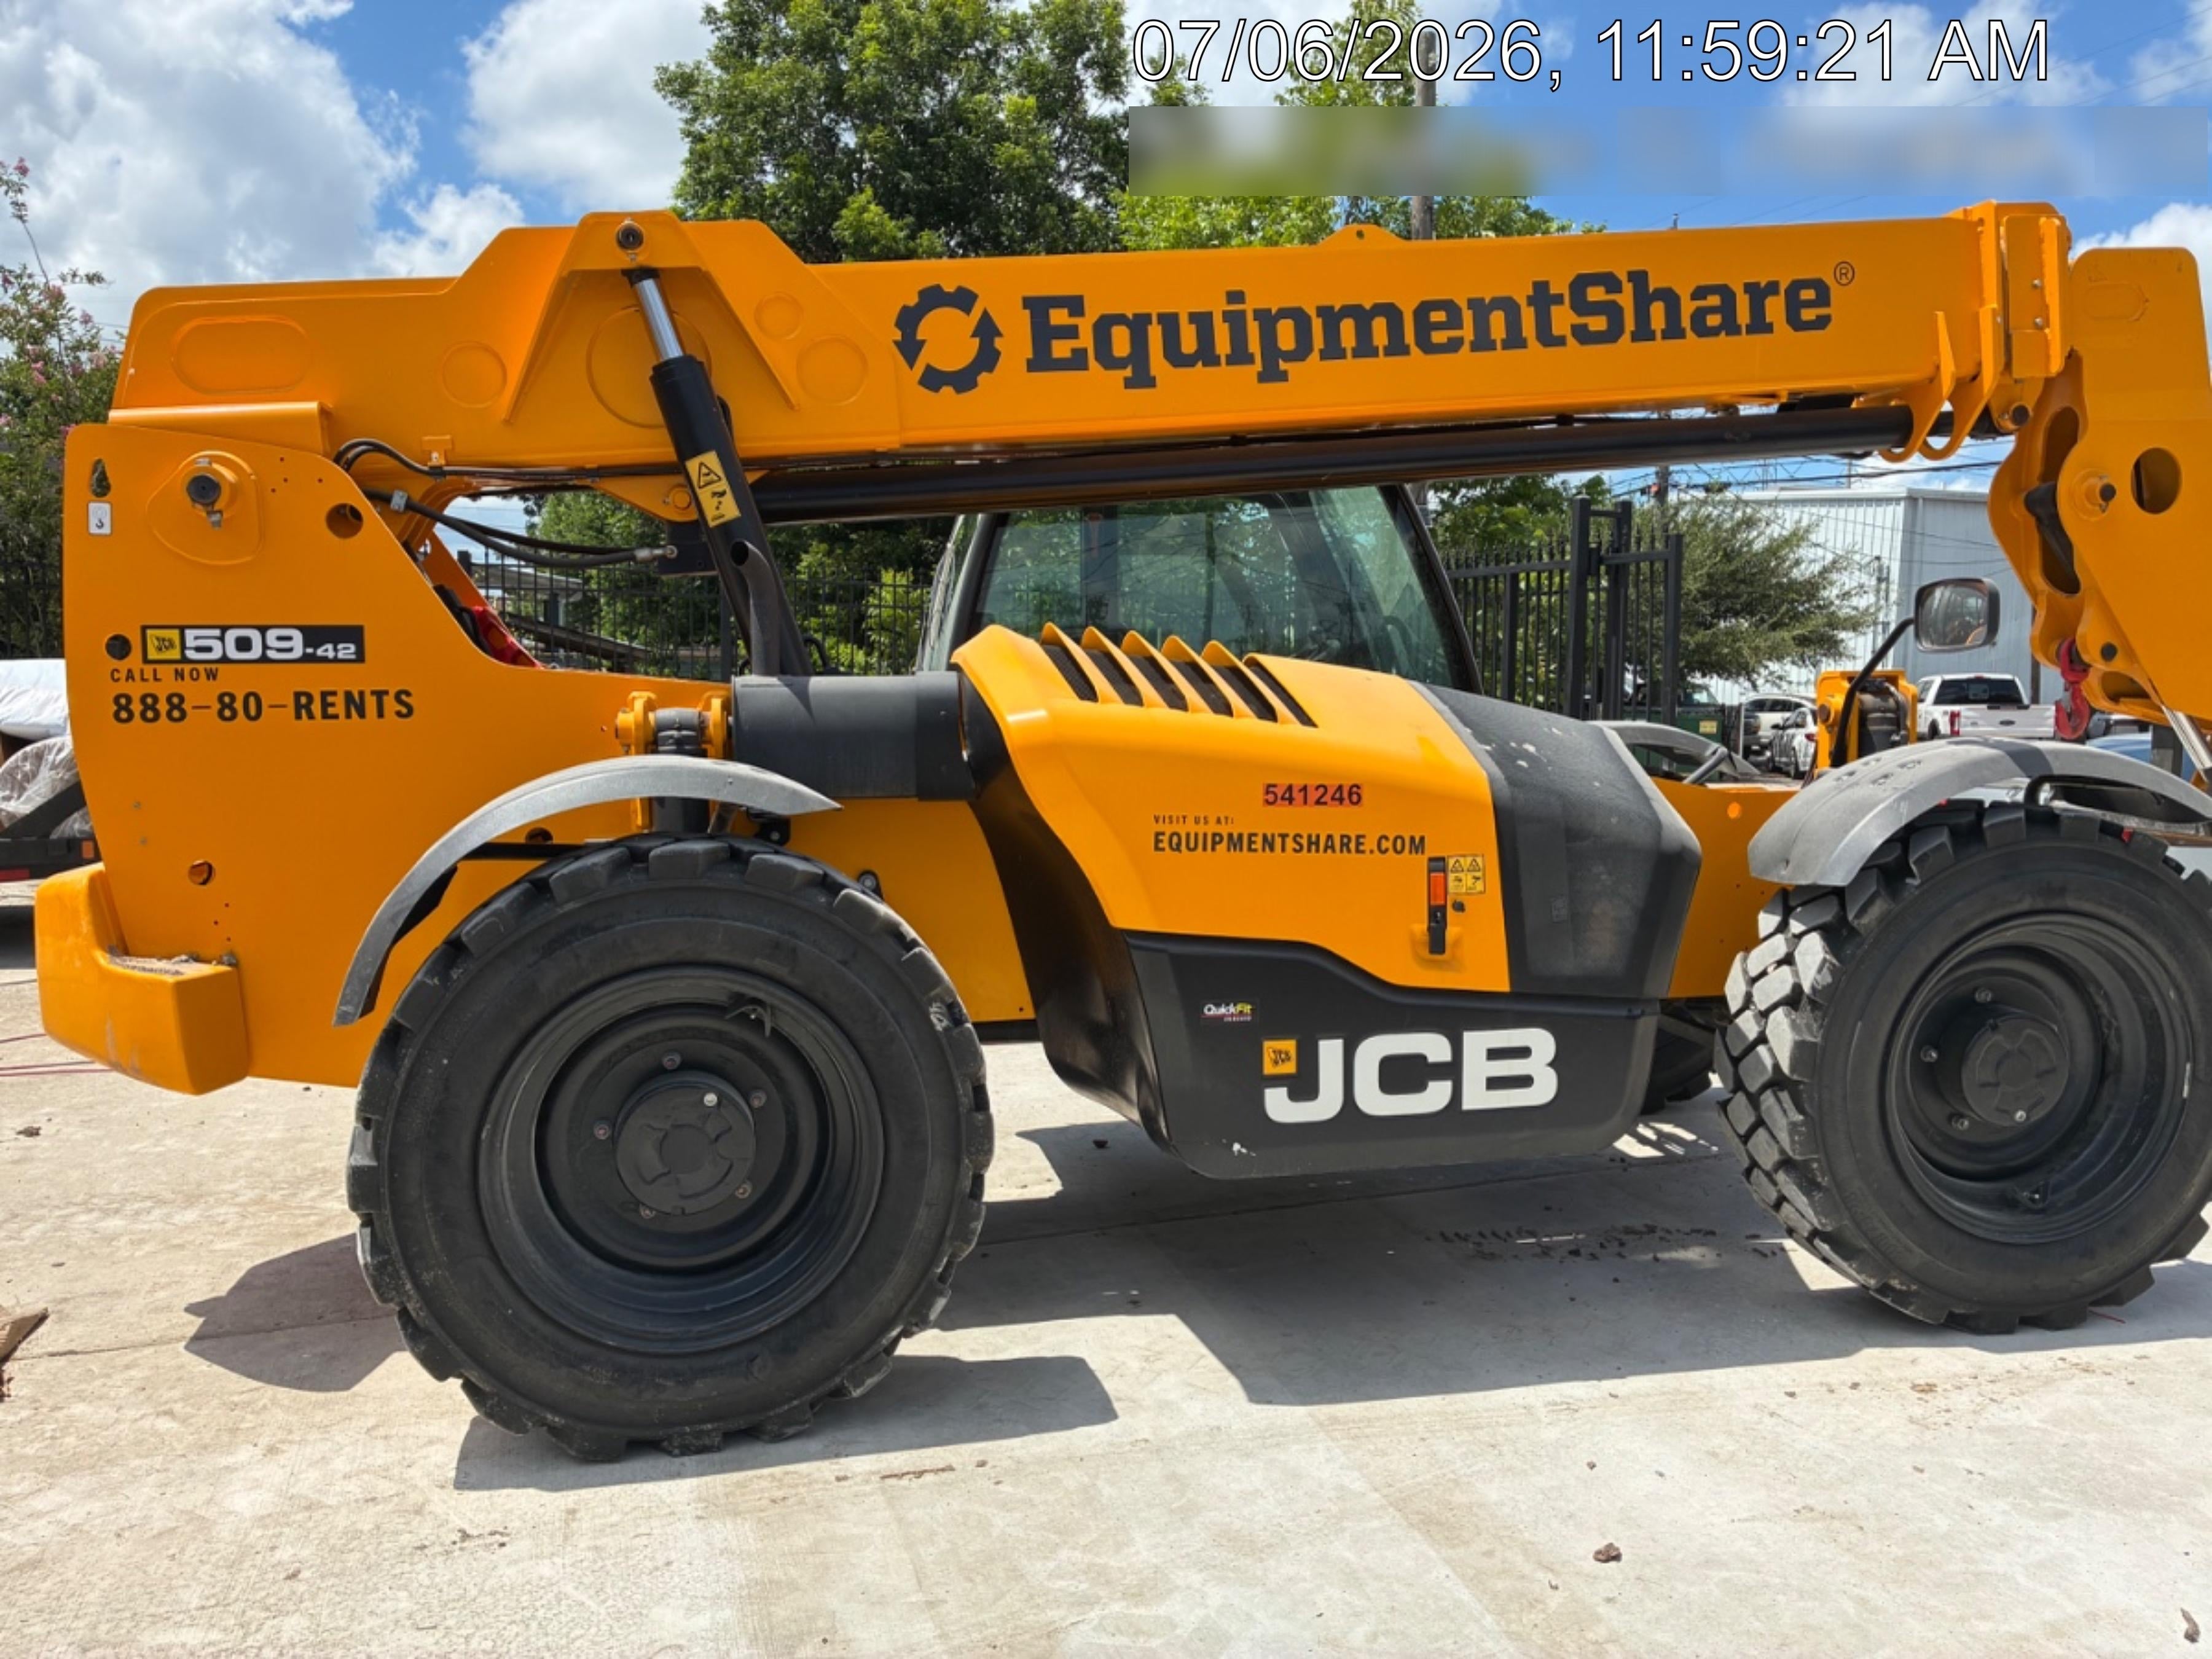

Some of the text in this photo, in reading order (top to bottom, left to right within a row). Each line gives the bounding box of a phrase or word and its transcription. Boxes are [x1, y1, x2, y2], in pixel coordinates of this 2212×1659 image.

[184, 628, 356, 660] 509-42
[111, 667, 219, 682] CALL NOW
[112, 689, 414, 724] 888-80-RENTS
[1265, 783, 1362, 806] 541246
[1153, 814, 1234, 825] VISIT US AT:
[1153, 831, 1426, 855] EQUIPMENTSHARE.COM
[1264, 1028, 1558, 1123] JCB
